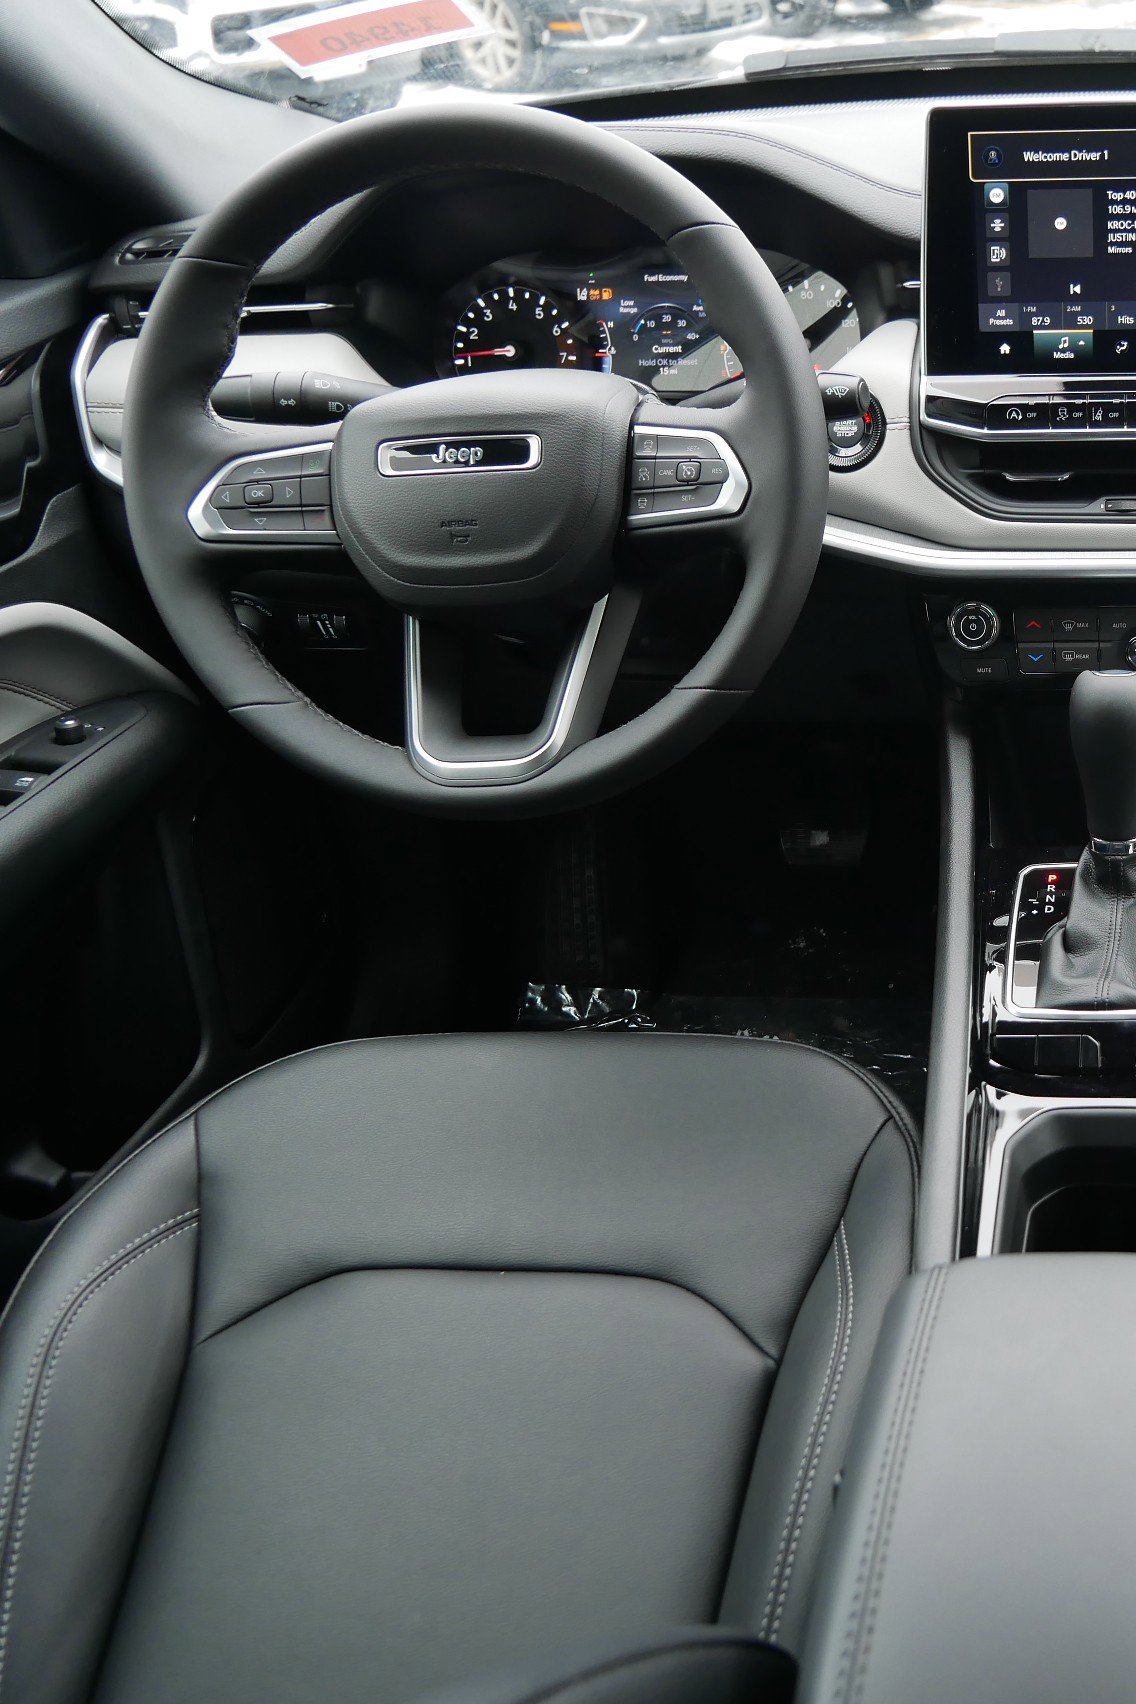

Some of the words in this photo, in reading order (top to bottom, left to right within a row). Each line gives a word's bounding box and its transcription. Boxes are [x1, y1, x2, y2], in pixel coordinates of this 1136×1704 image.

[1023, 151, 1069, 162] Welcome
[1071, 150, 1101, 161] Driver
[1103, 150, 1108, 160] 1
[1107, 191, 1124, 201] Top
[1124, 190, 1136, 200] 40
[1108, 205, 1131, 214] 106.9
[1107, 233, 1136, 242] JUSTIN
[1107, 246, 1133, 254] Mirrors
[659, 274, 688, 282] Economy
[800, 291, 814, 299] 80
[508, 300, 517, 311] 4
[826, 300, 841, 308] 100
[483, 309, 493, 321] 3
[535, 307, 544, 319] 5
[995, 309, 1006, 317] All
[841, 319, 856, 328] 120
[989, 318, 1013, 326] Presets
[1031, 317, 1050, 326] 87.9
[1077, 316, 1093, 325] 530
[1117, 315, 1134, 324] Hits
[469, 327, 478, 339] 2
[552, 324, 561, 336] 6
[652, 345, 682, 353] Current
[467, 355, 471, 367] 1
[559, 352, 567, 363] 7
[431, 444, 484, 465] Jeep
[251, 489, 265, 498] OK
[440, 519, 479, 529] AIRBAG
[1048, 874, 1057, 882] P
[1046, 894, 1055, 902] N
[1044, 905, 1054, 913] D
